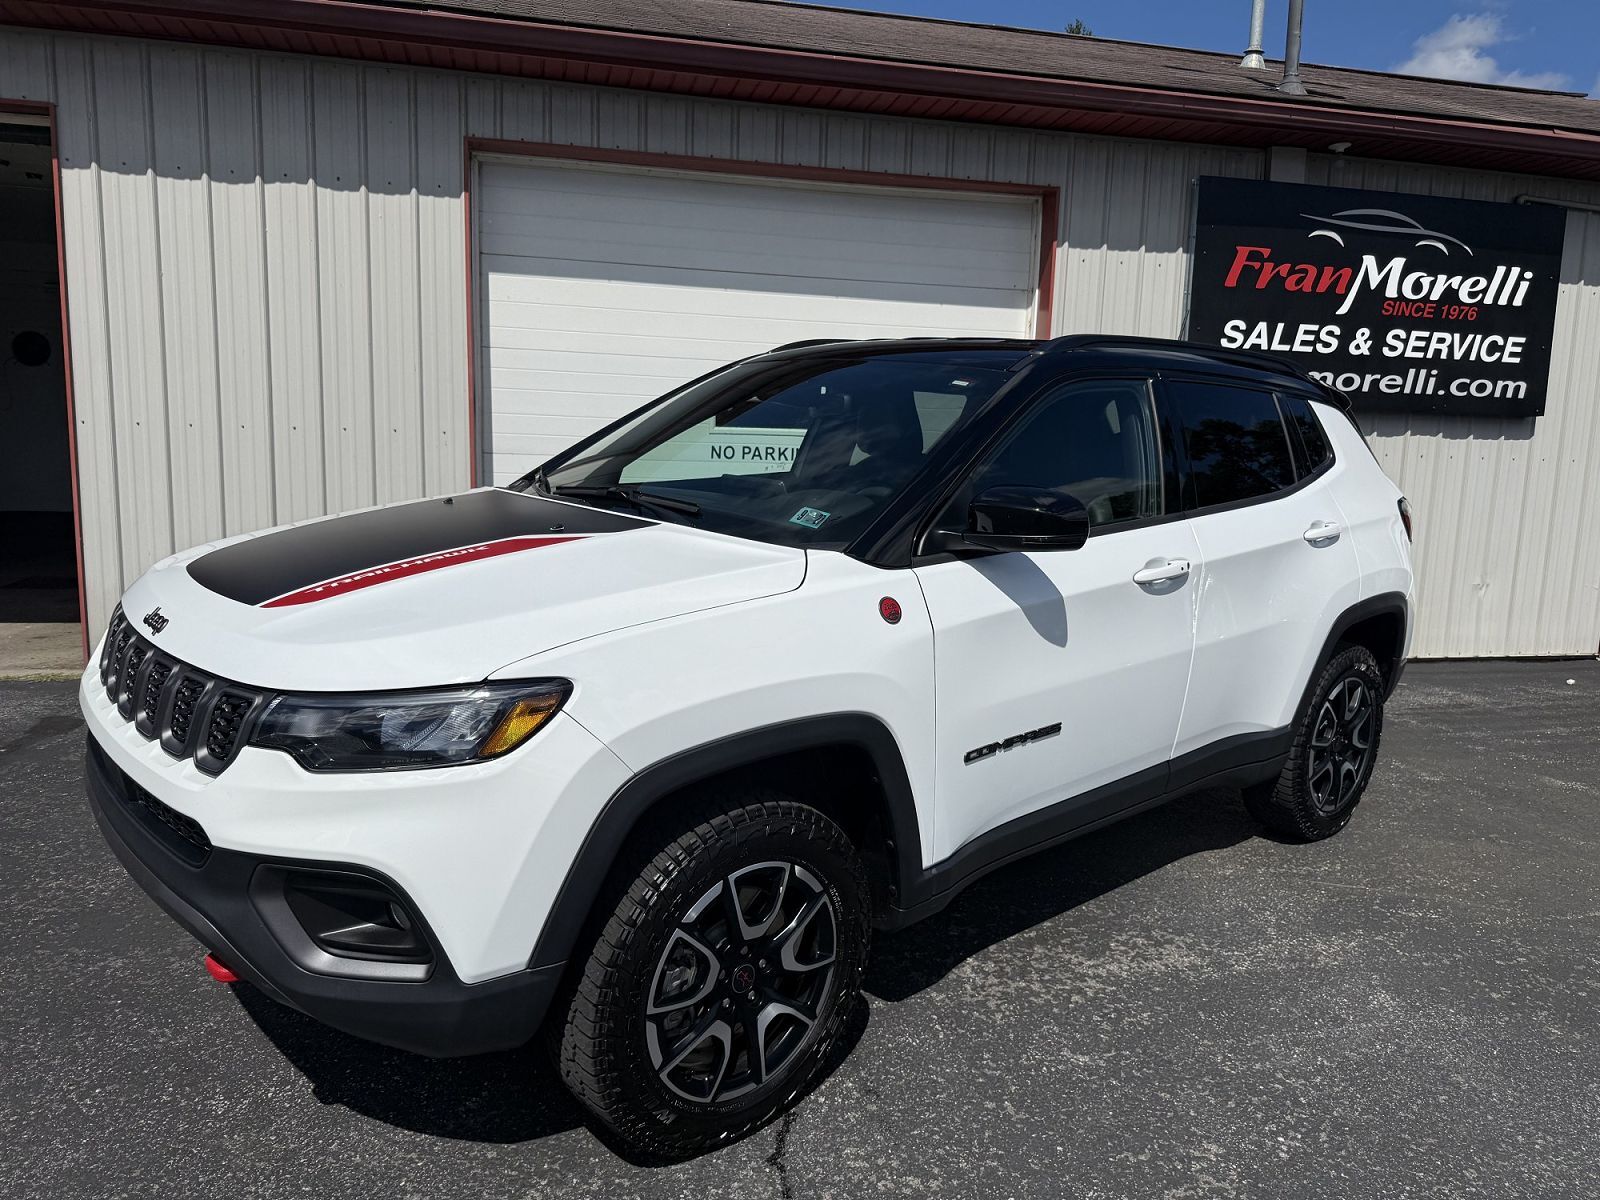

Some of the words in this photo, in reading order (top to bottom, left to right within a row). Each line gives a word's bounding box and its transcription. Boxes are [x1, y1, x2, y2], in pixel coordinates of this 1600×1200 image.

[1224, 245, 1353, 295] Fran
[1336, 254, 1534, 315] Morelli
[1382, 300, 1437, 319] SINCE
[1441, 304, 1479, 321] 1976
[1220, 319, 1341, 354] SALES
[1348, 327, 1373, 356] &
[1382, 328, 1527, 364] SERVICE
[711, 445, 736, 460] NO
[304, 545, 490, 594] TRAILHAWK
